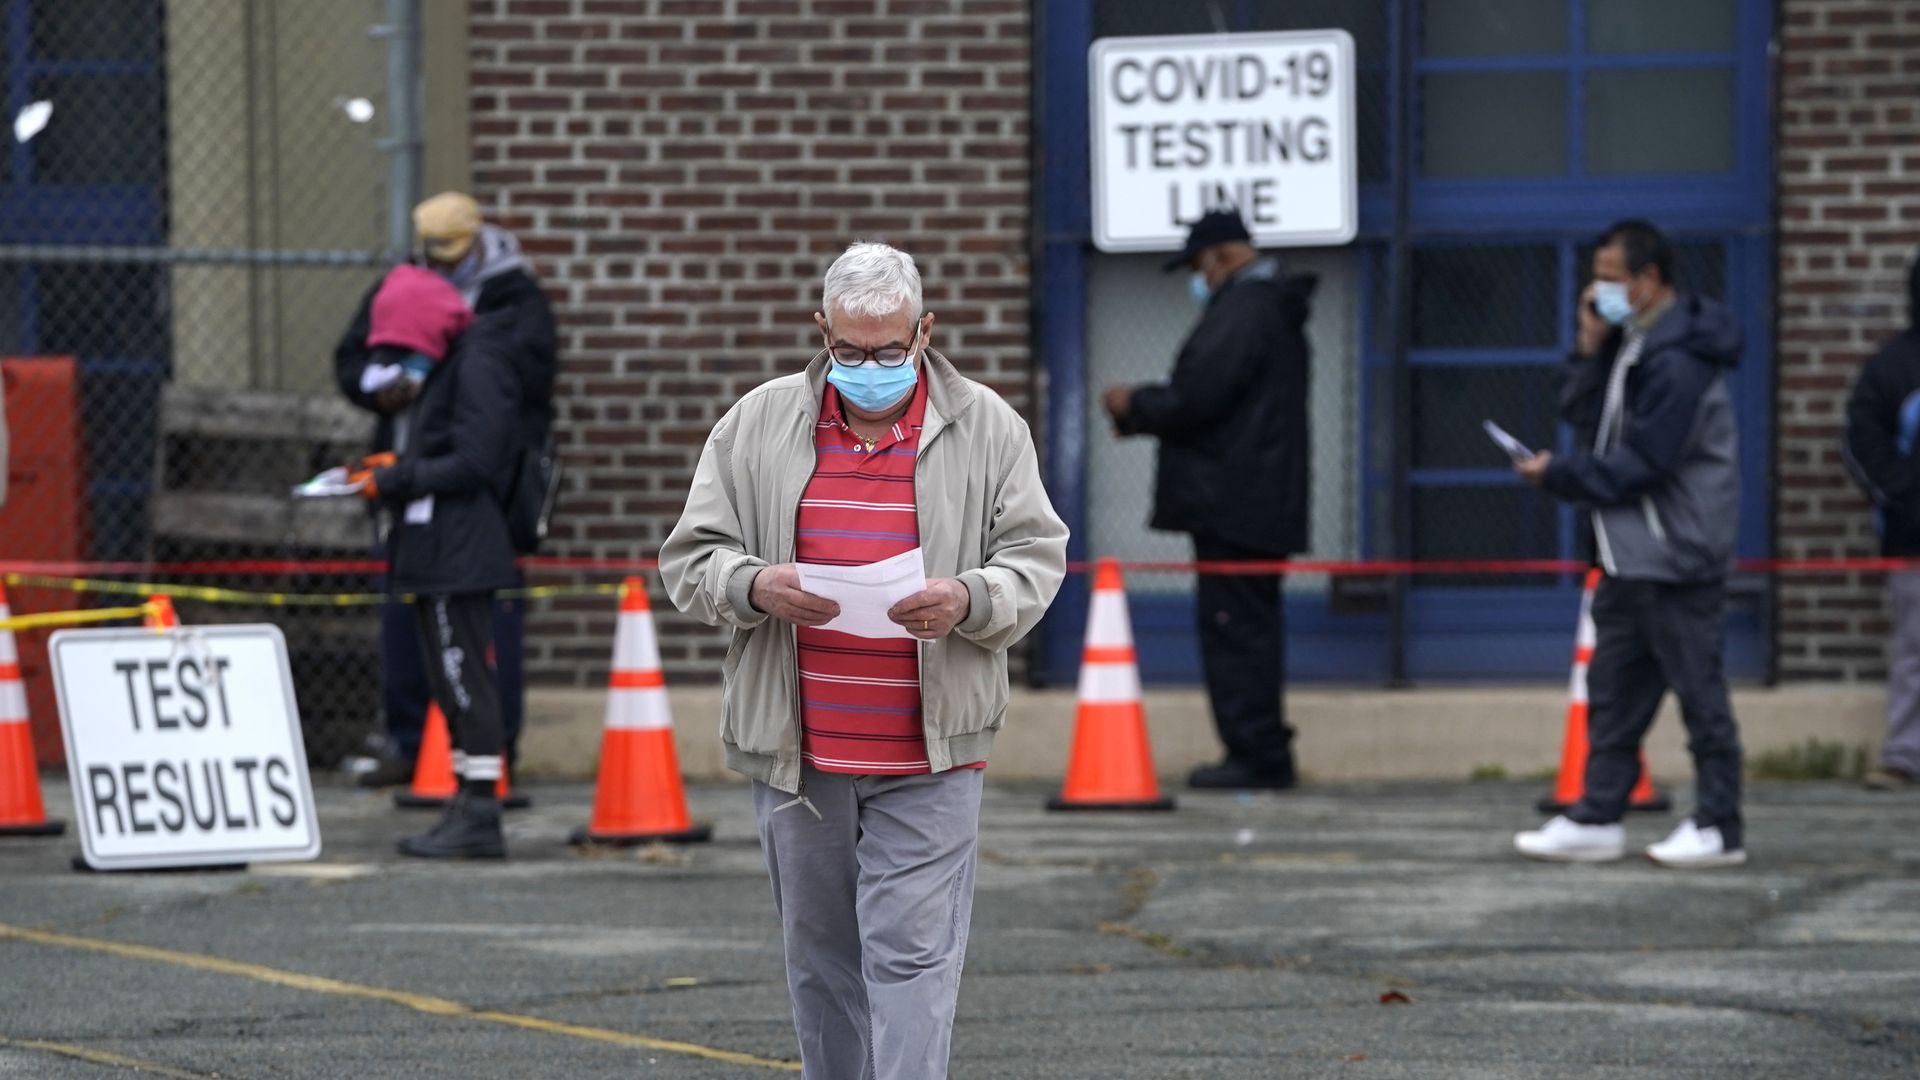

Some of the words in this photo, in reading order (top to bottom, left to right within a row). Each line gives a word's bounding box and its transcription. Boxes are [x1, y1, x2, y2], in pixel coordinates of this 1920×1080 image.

[1110, 51, 1332, 105] COVID-19
[1116, 117, 1331, 169] TESTING
[1169, 179, 1279, 227] LINE
[114, 656, 231, 731] TEST
[87, 757, 298, 836] RESULTS
